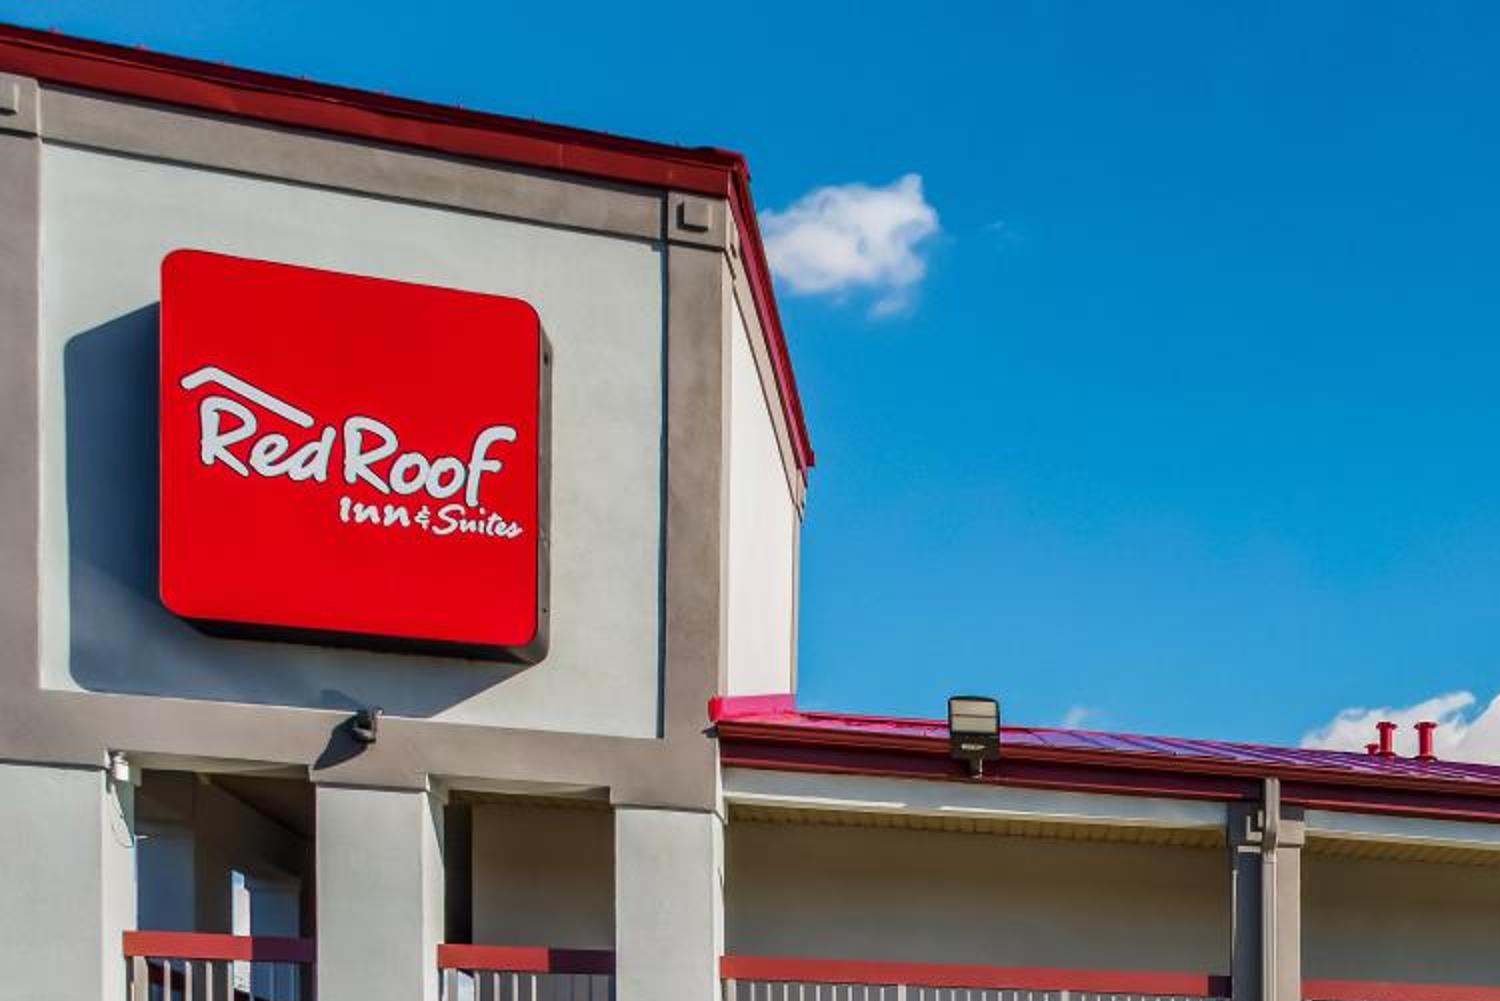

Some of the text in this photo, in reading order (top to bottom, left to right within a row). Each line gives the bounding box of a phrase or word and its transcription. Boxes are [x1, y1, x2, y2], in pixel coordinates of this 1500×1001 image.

[339, 496, 523, 539] Inn & Suites
